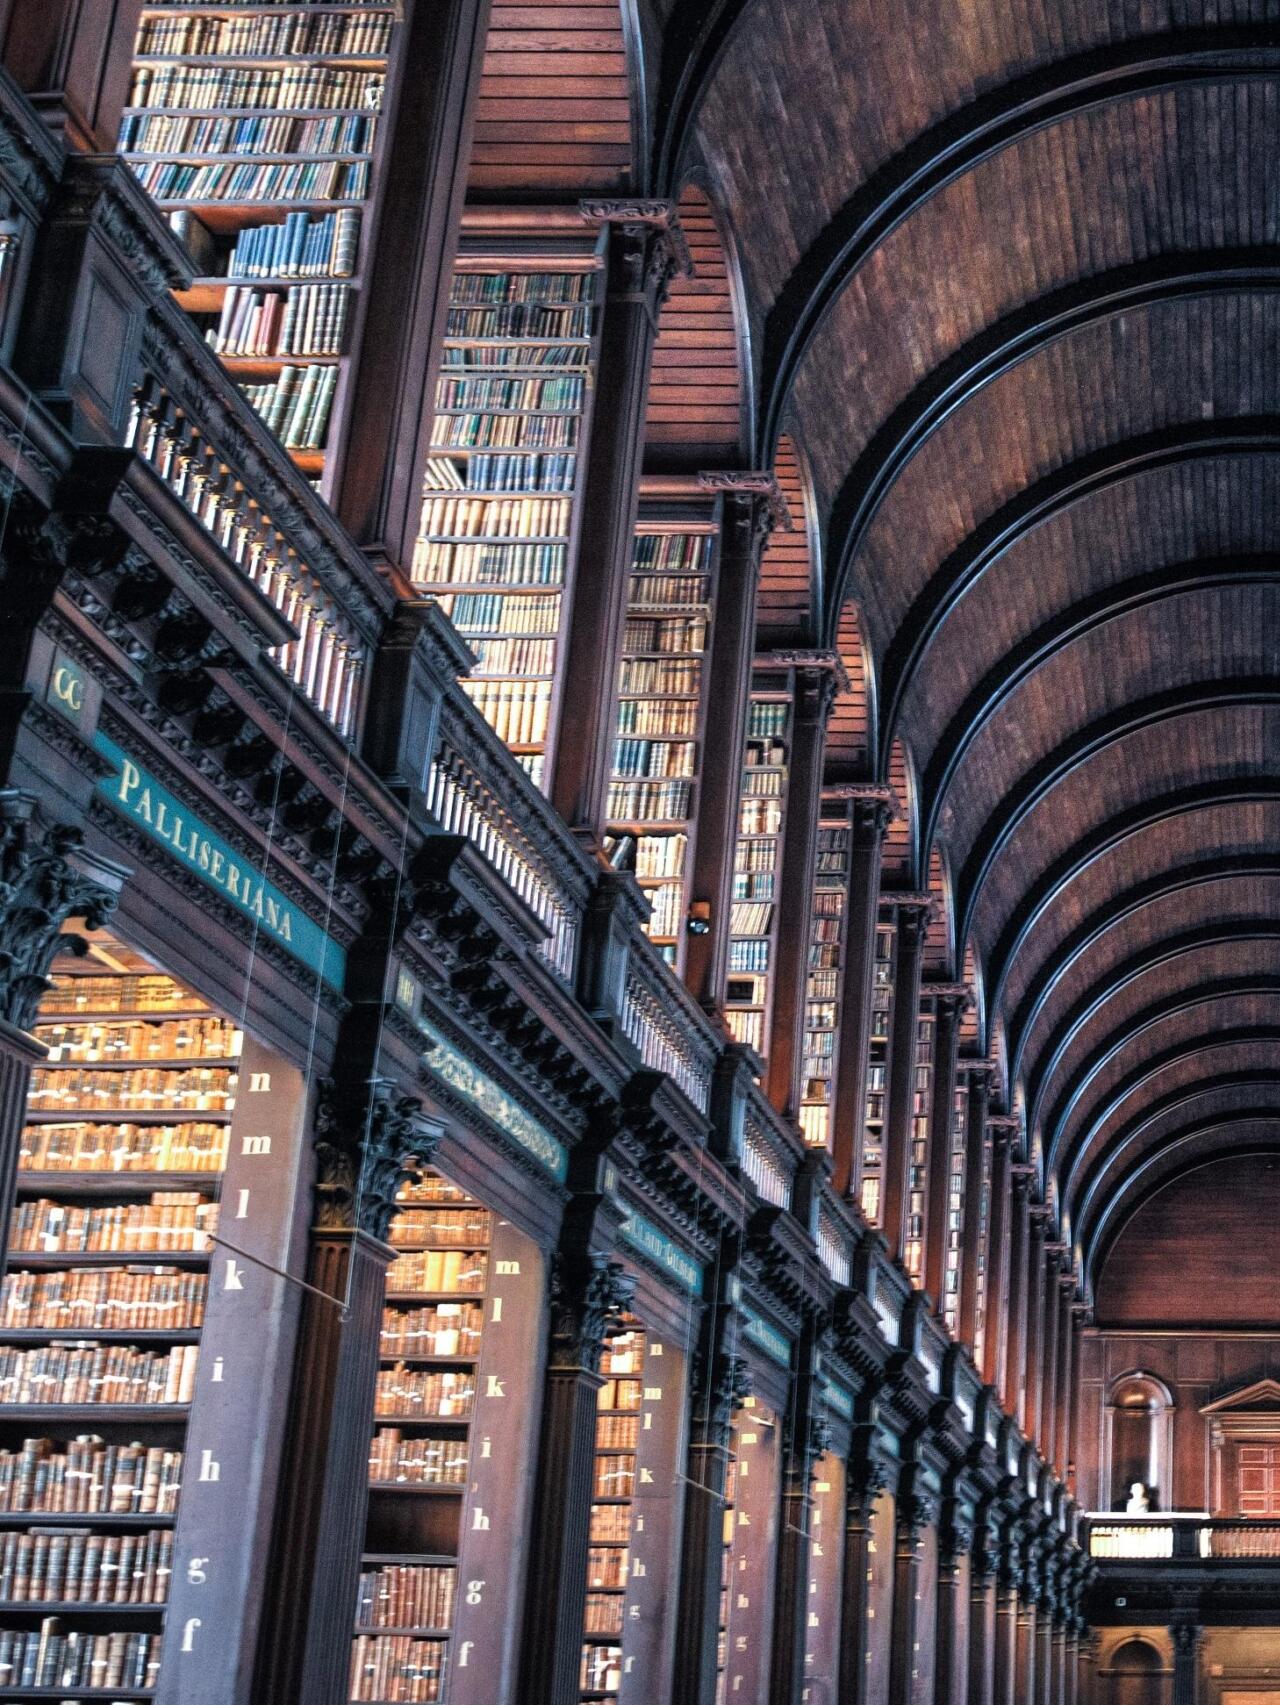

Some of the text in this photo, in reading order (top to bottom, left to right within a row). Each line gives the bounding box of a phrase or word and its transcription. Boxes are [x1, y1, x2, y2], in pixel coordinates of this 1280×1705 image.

[55, 668, 80, 709] CC
[118, 759, 292, 941] PALLISERIANA
[249, 1073, 270, 1091] n
[241, 1136, 271, 1154] m
[236, 1189, 249, 1218] l
[224, 1260, 244, 1290] k
[495, 1261, 520, 1274] m
[491, 1298, 502, 1321] l
[650, 1344, 662, 1355] n
[212, 1357, 223, 1381] i
[486, 1376, 505, 1397] k
[644, 1388, 661, 1399] m
[643, 1413, 651, 1429] l
[480, 1437, 490, 1457] i
[199, 1450, 219, 1481] h
[640, 1468, 653, 1482] k
[472, 1508, 489, 1530] h
[636, 1515, 643, 1531] i
[188, 1558, 209, 1584] g
[632, 1558, 645, 1576] h
[466, 1581, 485, 1604] g
[629, 1605, 640, 1620] g
[181, 1618, 201, 1651] f
[459, 1641, 474, 1666] f
[624, 1656, 635, 1672] f
